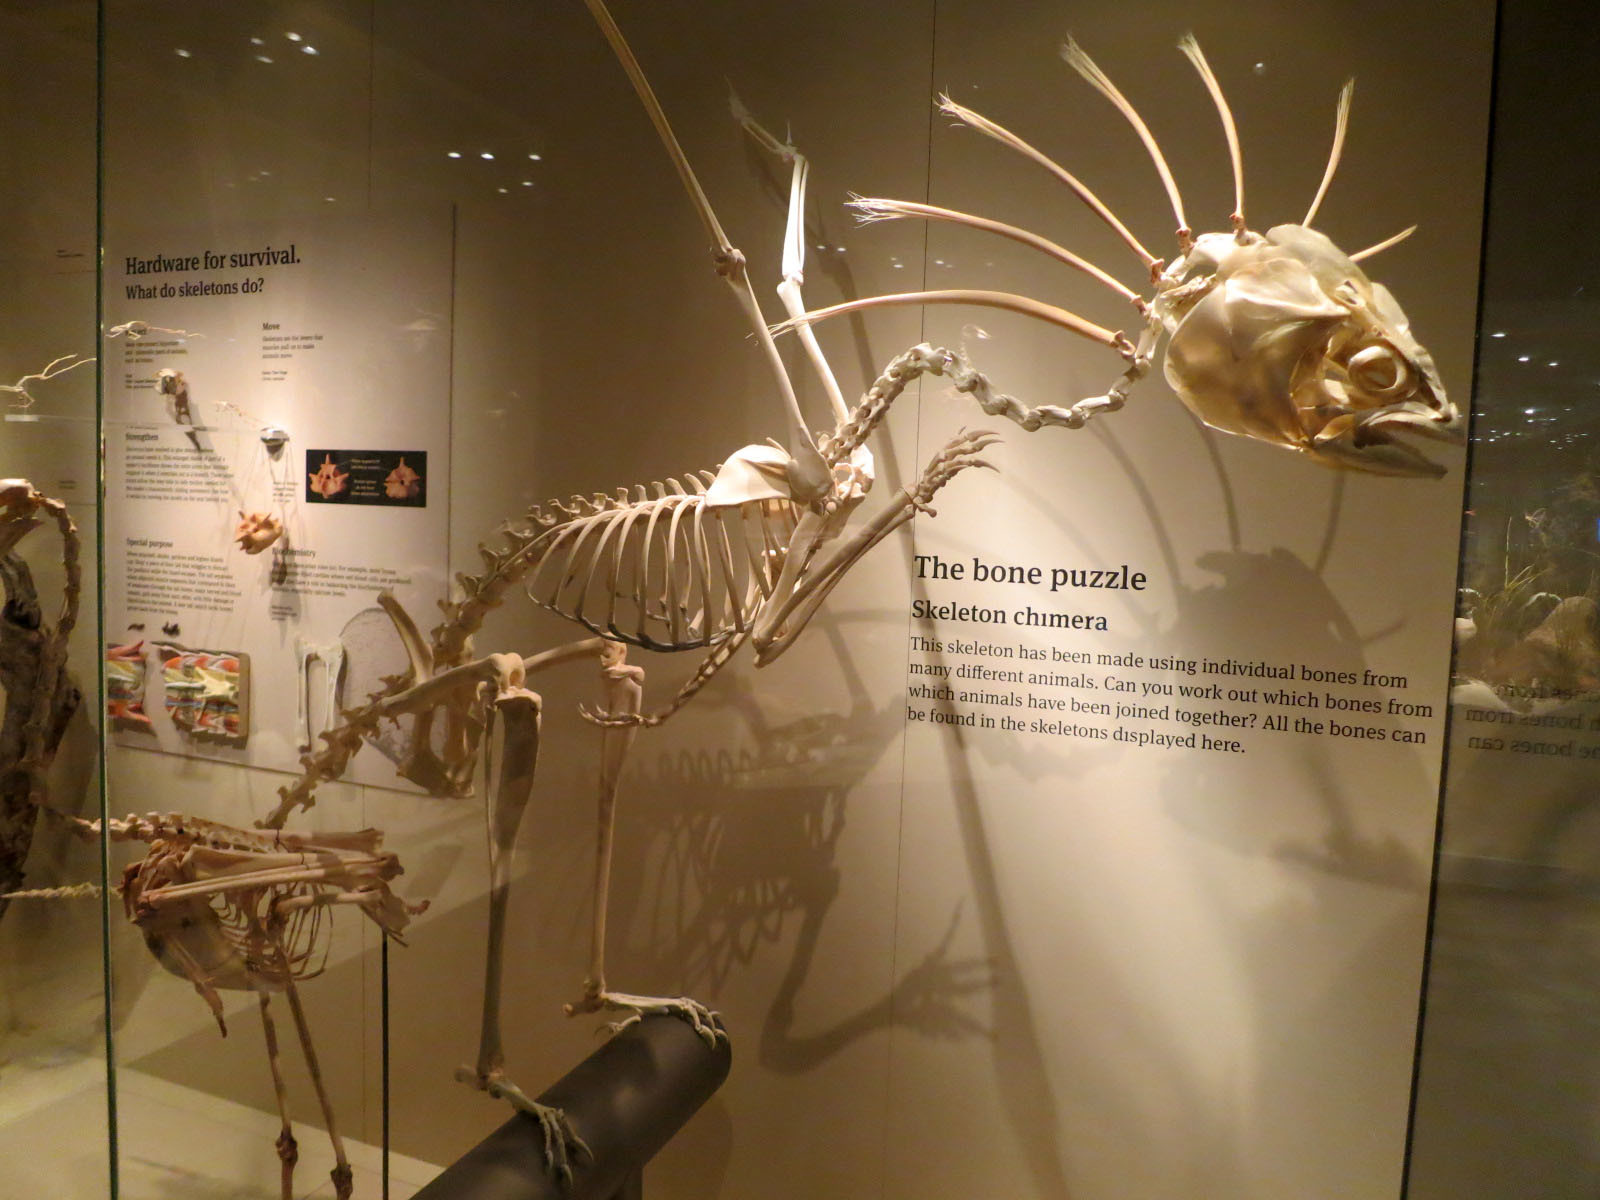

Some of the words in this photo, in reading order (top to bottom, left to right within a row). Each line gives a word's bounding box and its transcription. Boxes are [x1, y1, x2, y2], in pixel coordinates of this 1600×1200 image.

[126, 253, 200, 275] Hardware
[204, 250, 226, 270] for
[230, 244, 301, 267] survival.
[126, 284, 157, 300] What
[161, 282, 176, 298] do
[179, 280, 238, 297] skeletons
[241, 278, 264, 294] do?
[914, 555, 964, 580] The
[972, 558, 1042, 585] bone
[1050, 565, 1147, 592] puzzle
[912, 600, 1006, 624] Skeleton
[1014, 606, 1108, 631] chimera
[910, 636, 943, 652] This
[947, 639, 1013, 658] skeleton
[1018, 644, 1046, 661] has
[1052, 647, 1091, 664] been
[1096, 652, 1144, 668] made
[1149, 656, 1197, 676] using
[1202, 658, 1295, 680] individual
[1300, 664, 1357, 685] bones
[1362, 670, 1408, 689] from
[909, 662, 952, 680] many
[956, 664, 1023, 683] different
[1028, 672, 1099, 690] animals.
[1104, 676, 1136, 692] Can
[1142, 682, 1173, 697] you
[1178, 684, 1222, 700] work
[1228, 688, 1258, 704] out
[1263, 690, 1319, 708] which
[1325, 693, 1382, 714] bones
[1387, 698, 1433, 718] from
[907, 706, 926, 721] be
[930, 709, 976, 728] found
[980, 713, 996, 729] in
[1000, 716, 1026, 732] the
[1030, 718, 1108, 740] skeletons
[1112, 726, 1196, 750] displayed
[1202, 734, 1246, 753] here.
[908, 684, 955, 701] which
[960, 689, 1023, 707] animals
[1028, 694, 1066, 712] have
[1070, 696, 1110, 716] been
[1115, 702, 1169, 721] joined
[1175, 709, 1257, 728] together?
[1262, 714, 1288, 732] All
[1294, 718, 1324, 735] the
[1329, 720, 1386, 740] bones
[1391, 728, 1426, 744] can
